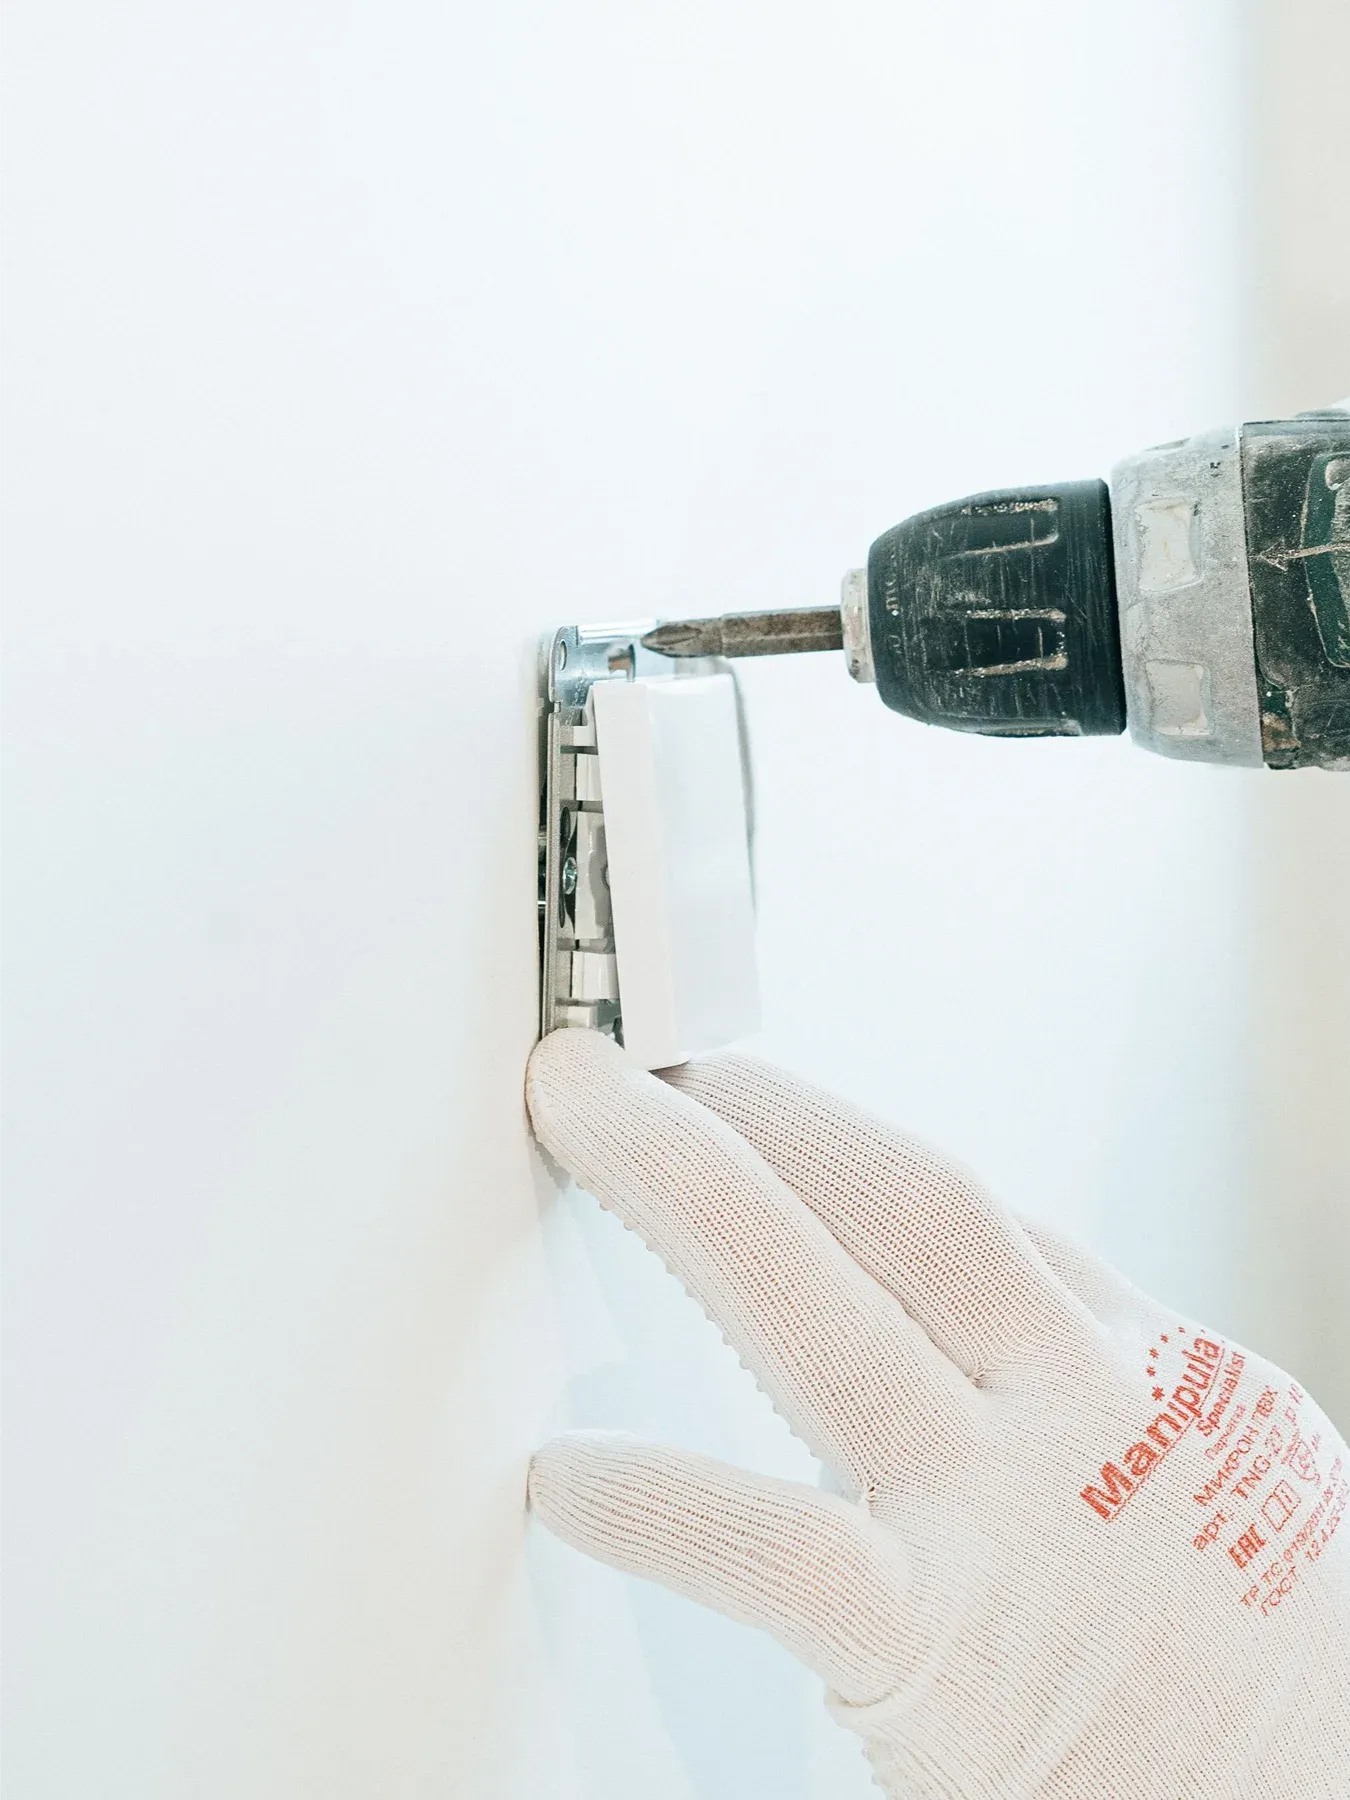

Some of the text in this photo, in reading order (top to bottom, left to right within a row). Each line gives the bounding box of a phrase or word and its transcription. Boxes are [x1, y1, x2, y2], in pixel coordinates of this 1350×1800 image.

[1079, 1337, 1221, 1520] Manipula
[1197, 1351, 1247, 1437] Specialist
[1193, 1425, 1260, 1507] МИКРОН
